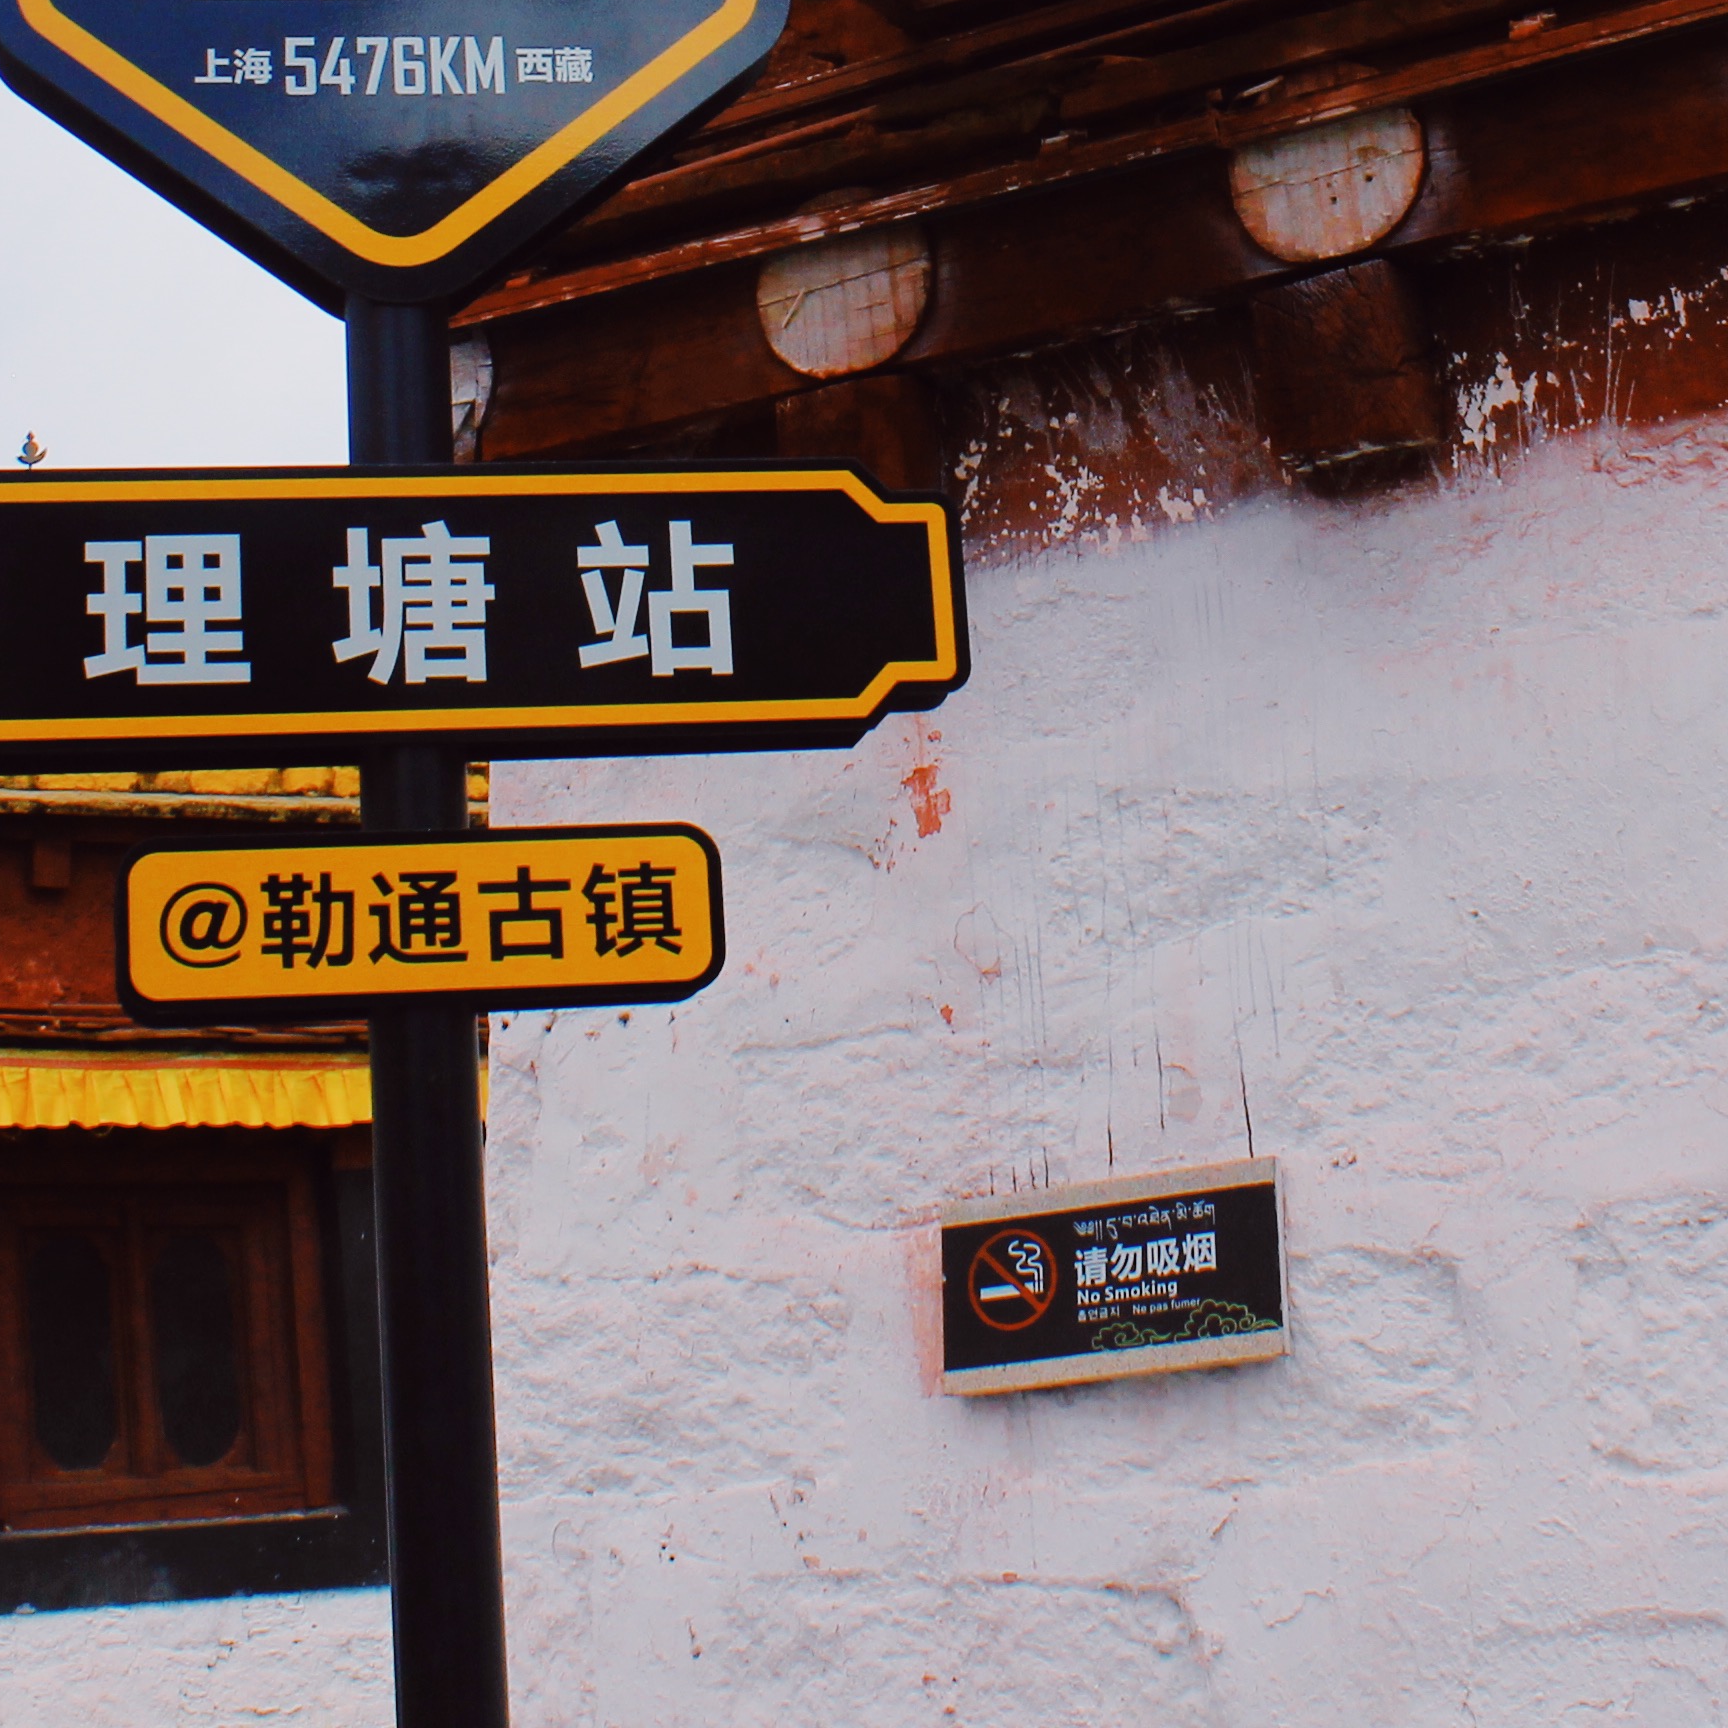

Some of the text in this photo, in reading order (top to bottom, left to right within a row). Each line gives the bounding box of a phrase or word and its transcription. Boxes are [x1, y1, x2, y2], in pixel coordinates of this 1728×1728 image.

[193, 35, 594, 96] 上海 5476KM 西藏
[82, 518, 737, 686] 理塘站
[158, 860, 684, 970] @勒通古镇
[1074, 1230, 1218, 1287] 请勿吸烟
[1077, 1278, 1178, 1305] No Smoking
[1132, 1297, 1201, 1315] Ne pas fumer
